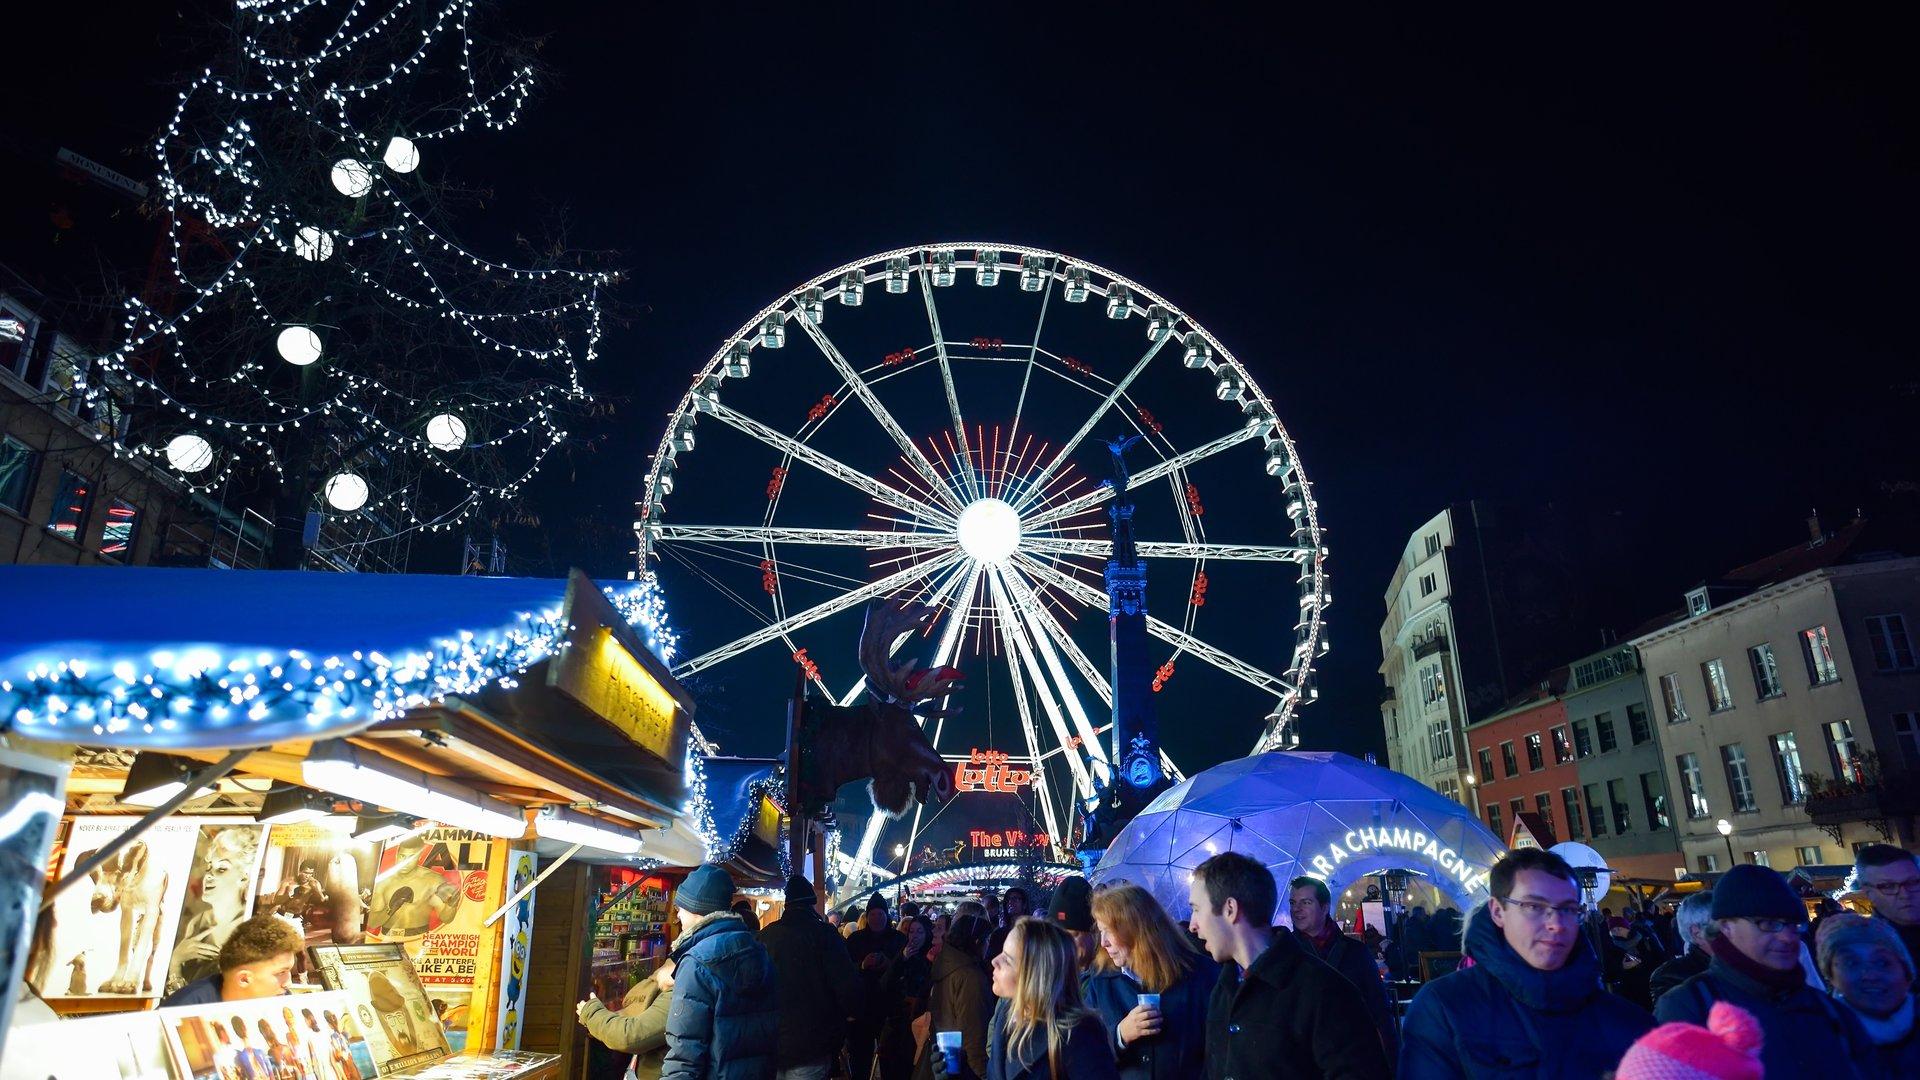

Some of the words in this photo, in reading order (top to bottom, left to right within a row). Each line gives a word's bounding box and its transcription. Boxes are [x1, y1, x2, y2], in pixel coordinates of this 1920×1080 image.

[970, 831, 1002, 847] The
[1307, 855, 1334, 881] AR
[1345, 826, 1484, 894] CHAMPAGNE
[445, 965, 454, 973] A
